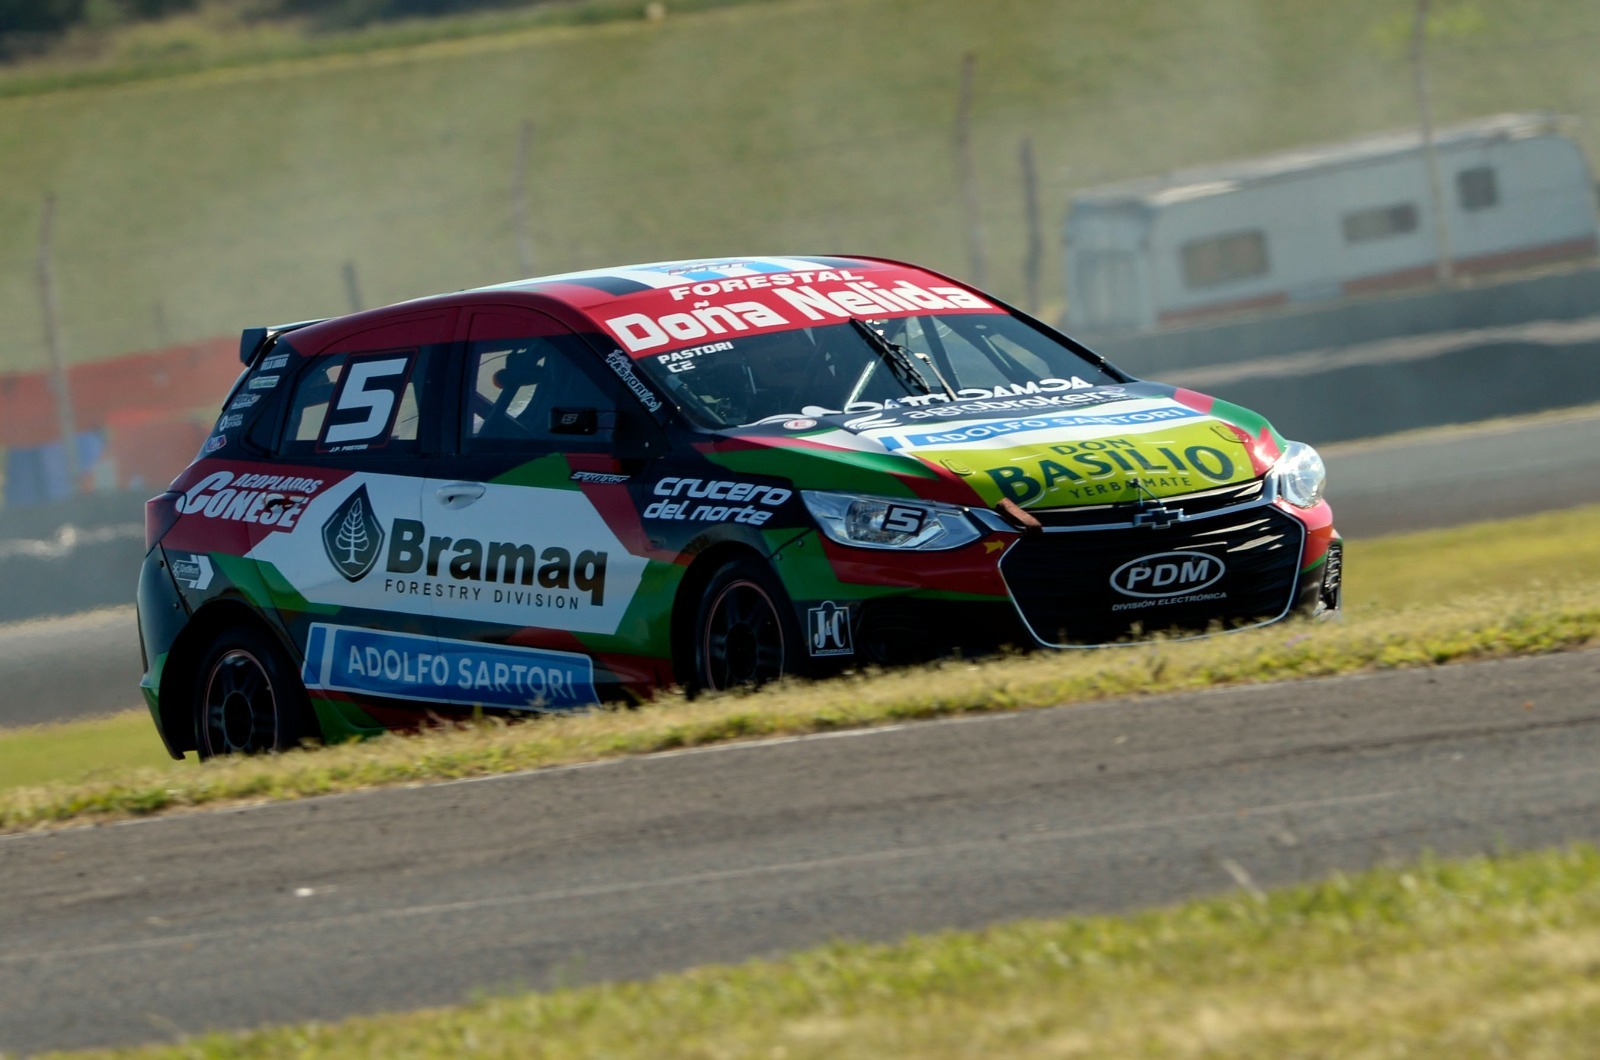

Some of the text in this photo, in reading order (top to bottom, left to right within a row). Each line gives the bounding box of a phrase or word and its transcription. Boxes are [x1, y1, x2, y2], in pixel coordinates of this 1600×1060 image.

[668, 270, 865, 302] FORESTAL
[605, 279, 994, 353] Doña Nelida
[657, 341, 734, 364] PASTORI
[324, 357, 408, 444] 5
[903, 388, 1127, 419] agrobrokers
[924, 407, 1185, 444] ADOLFO SARTORI
[1050, 438, 1137, 456] DON
[985, 446, 1234, 504] BASILIO
[1141, 477, 1193, 489] MATE
[643, 499, 774, 526] del norte
[885, 507, 922, 533] 5
[386, 518, 608, 607] Bramaq
[1126, 559, 1210, 590] PDM
[385, 579, 579, 610] FORESTRY DIVISION
[814, 610, 846, 649] J&C
[348, 645, 577, 700] ADOLFO SARTORI
